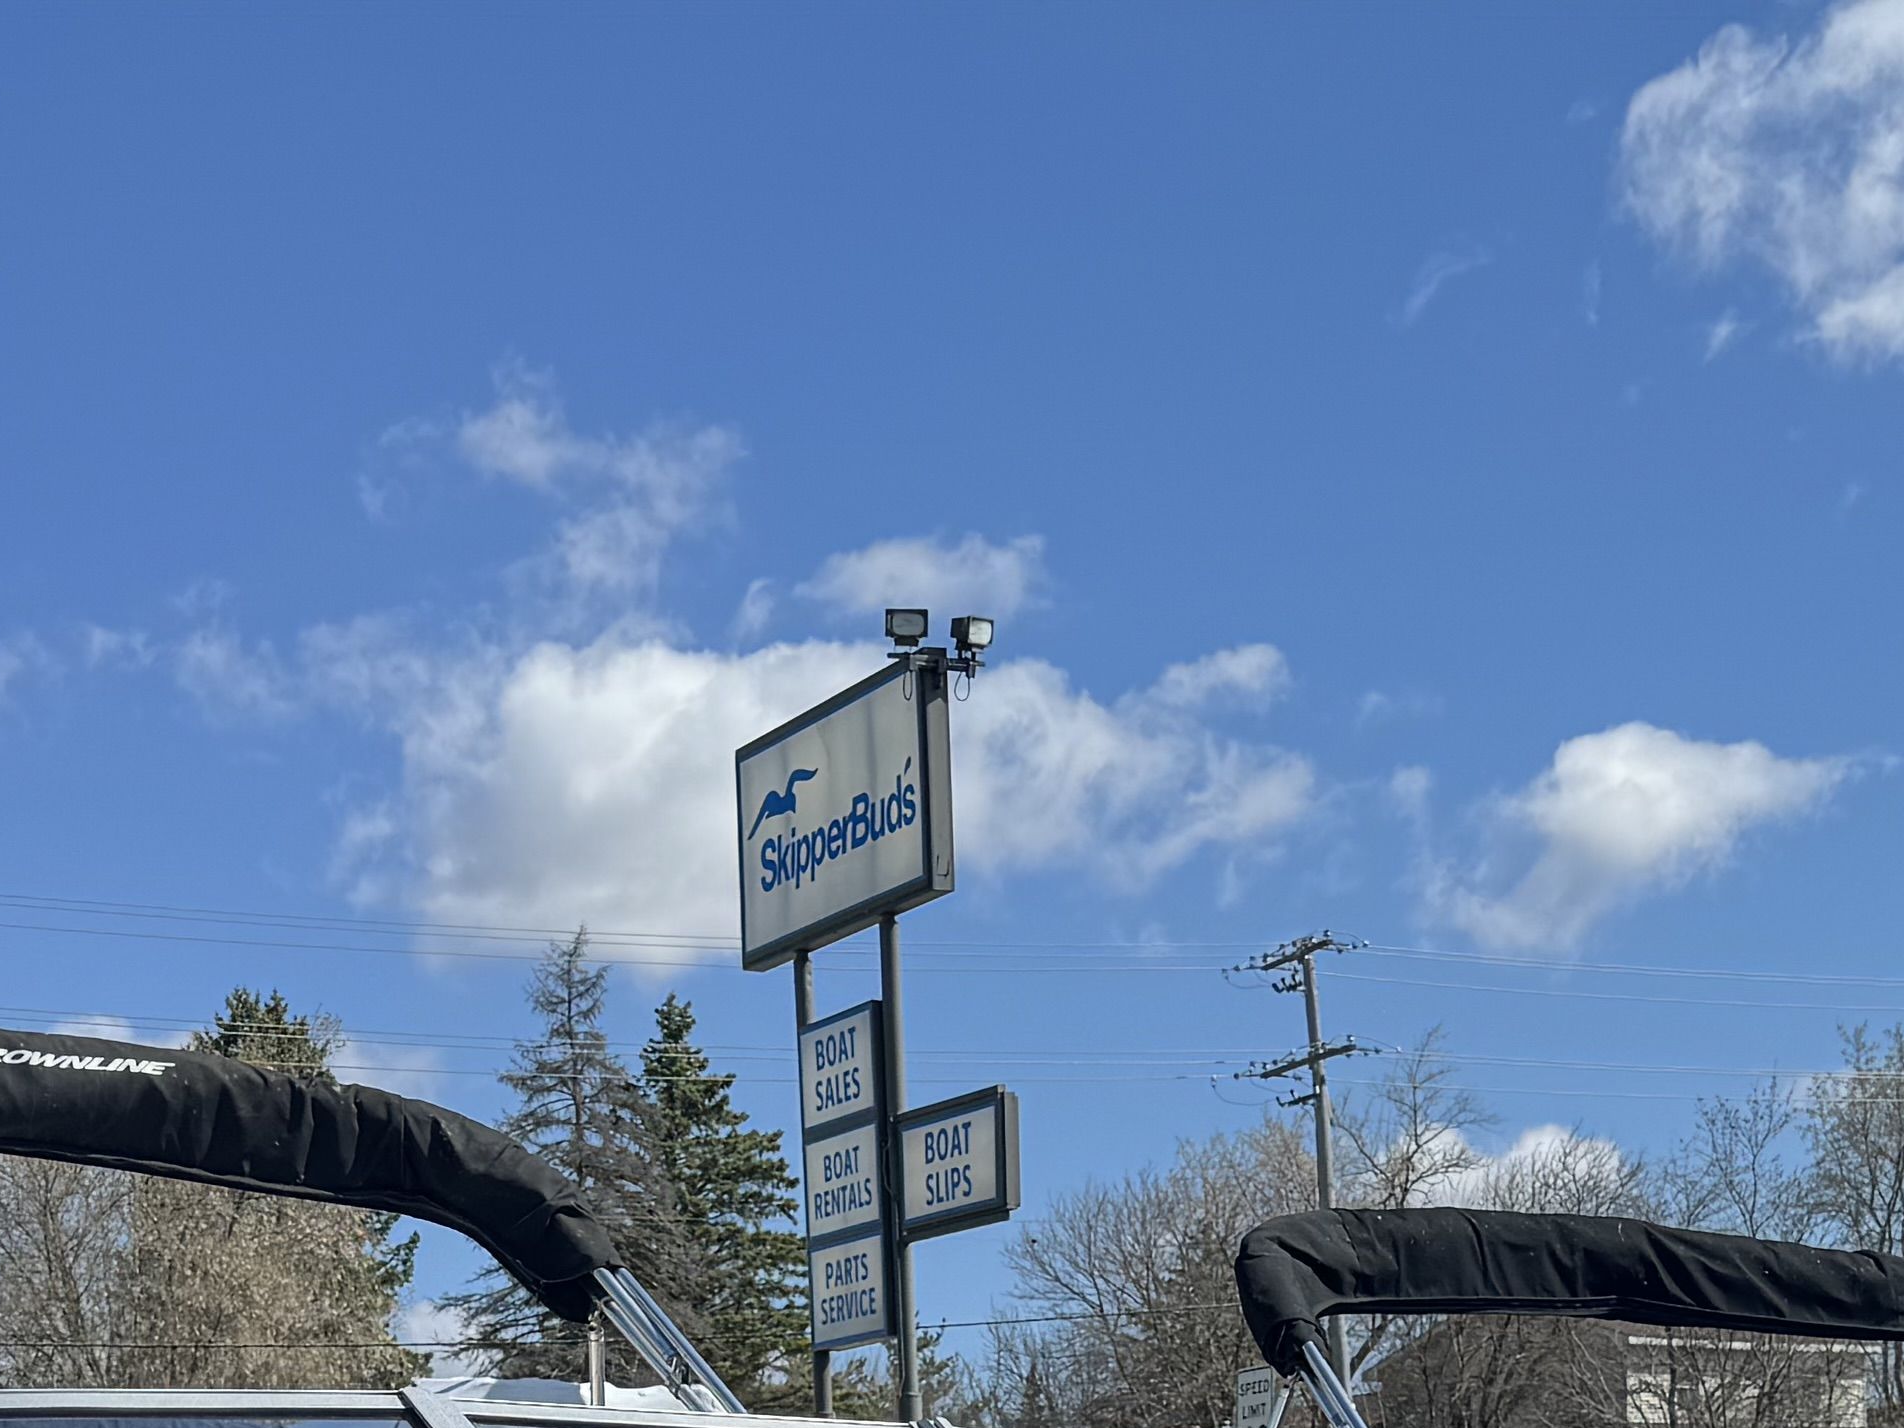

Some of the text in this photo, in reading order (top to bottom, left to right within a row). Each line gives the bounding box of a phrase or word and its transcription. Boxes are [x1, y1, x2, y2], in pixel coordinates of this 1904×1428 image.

[815, 1027, 857, 1070] BOAT
[815, 1069, 861, 1110] SALES
[924, 1121, 972, 1165] BOAT
[824, 1145, 860, 1182] BOAT
[814, 1178, 872, 1220] RENTALS
[925, 1164, 973, 1206] SLIPS
[825, 1253, 869, 1289] PARTS
[821, 1287, 877, 1325] SERVICE
[1239, 1379, 1270, 1397] SPEED
[1242, 1402, 1266, 1420] LIMIT
